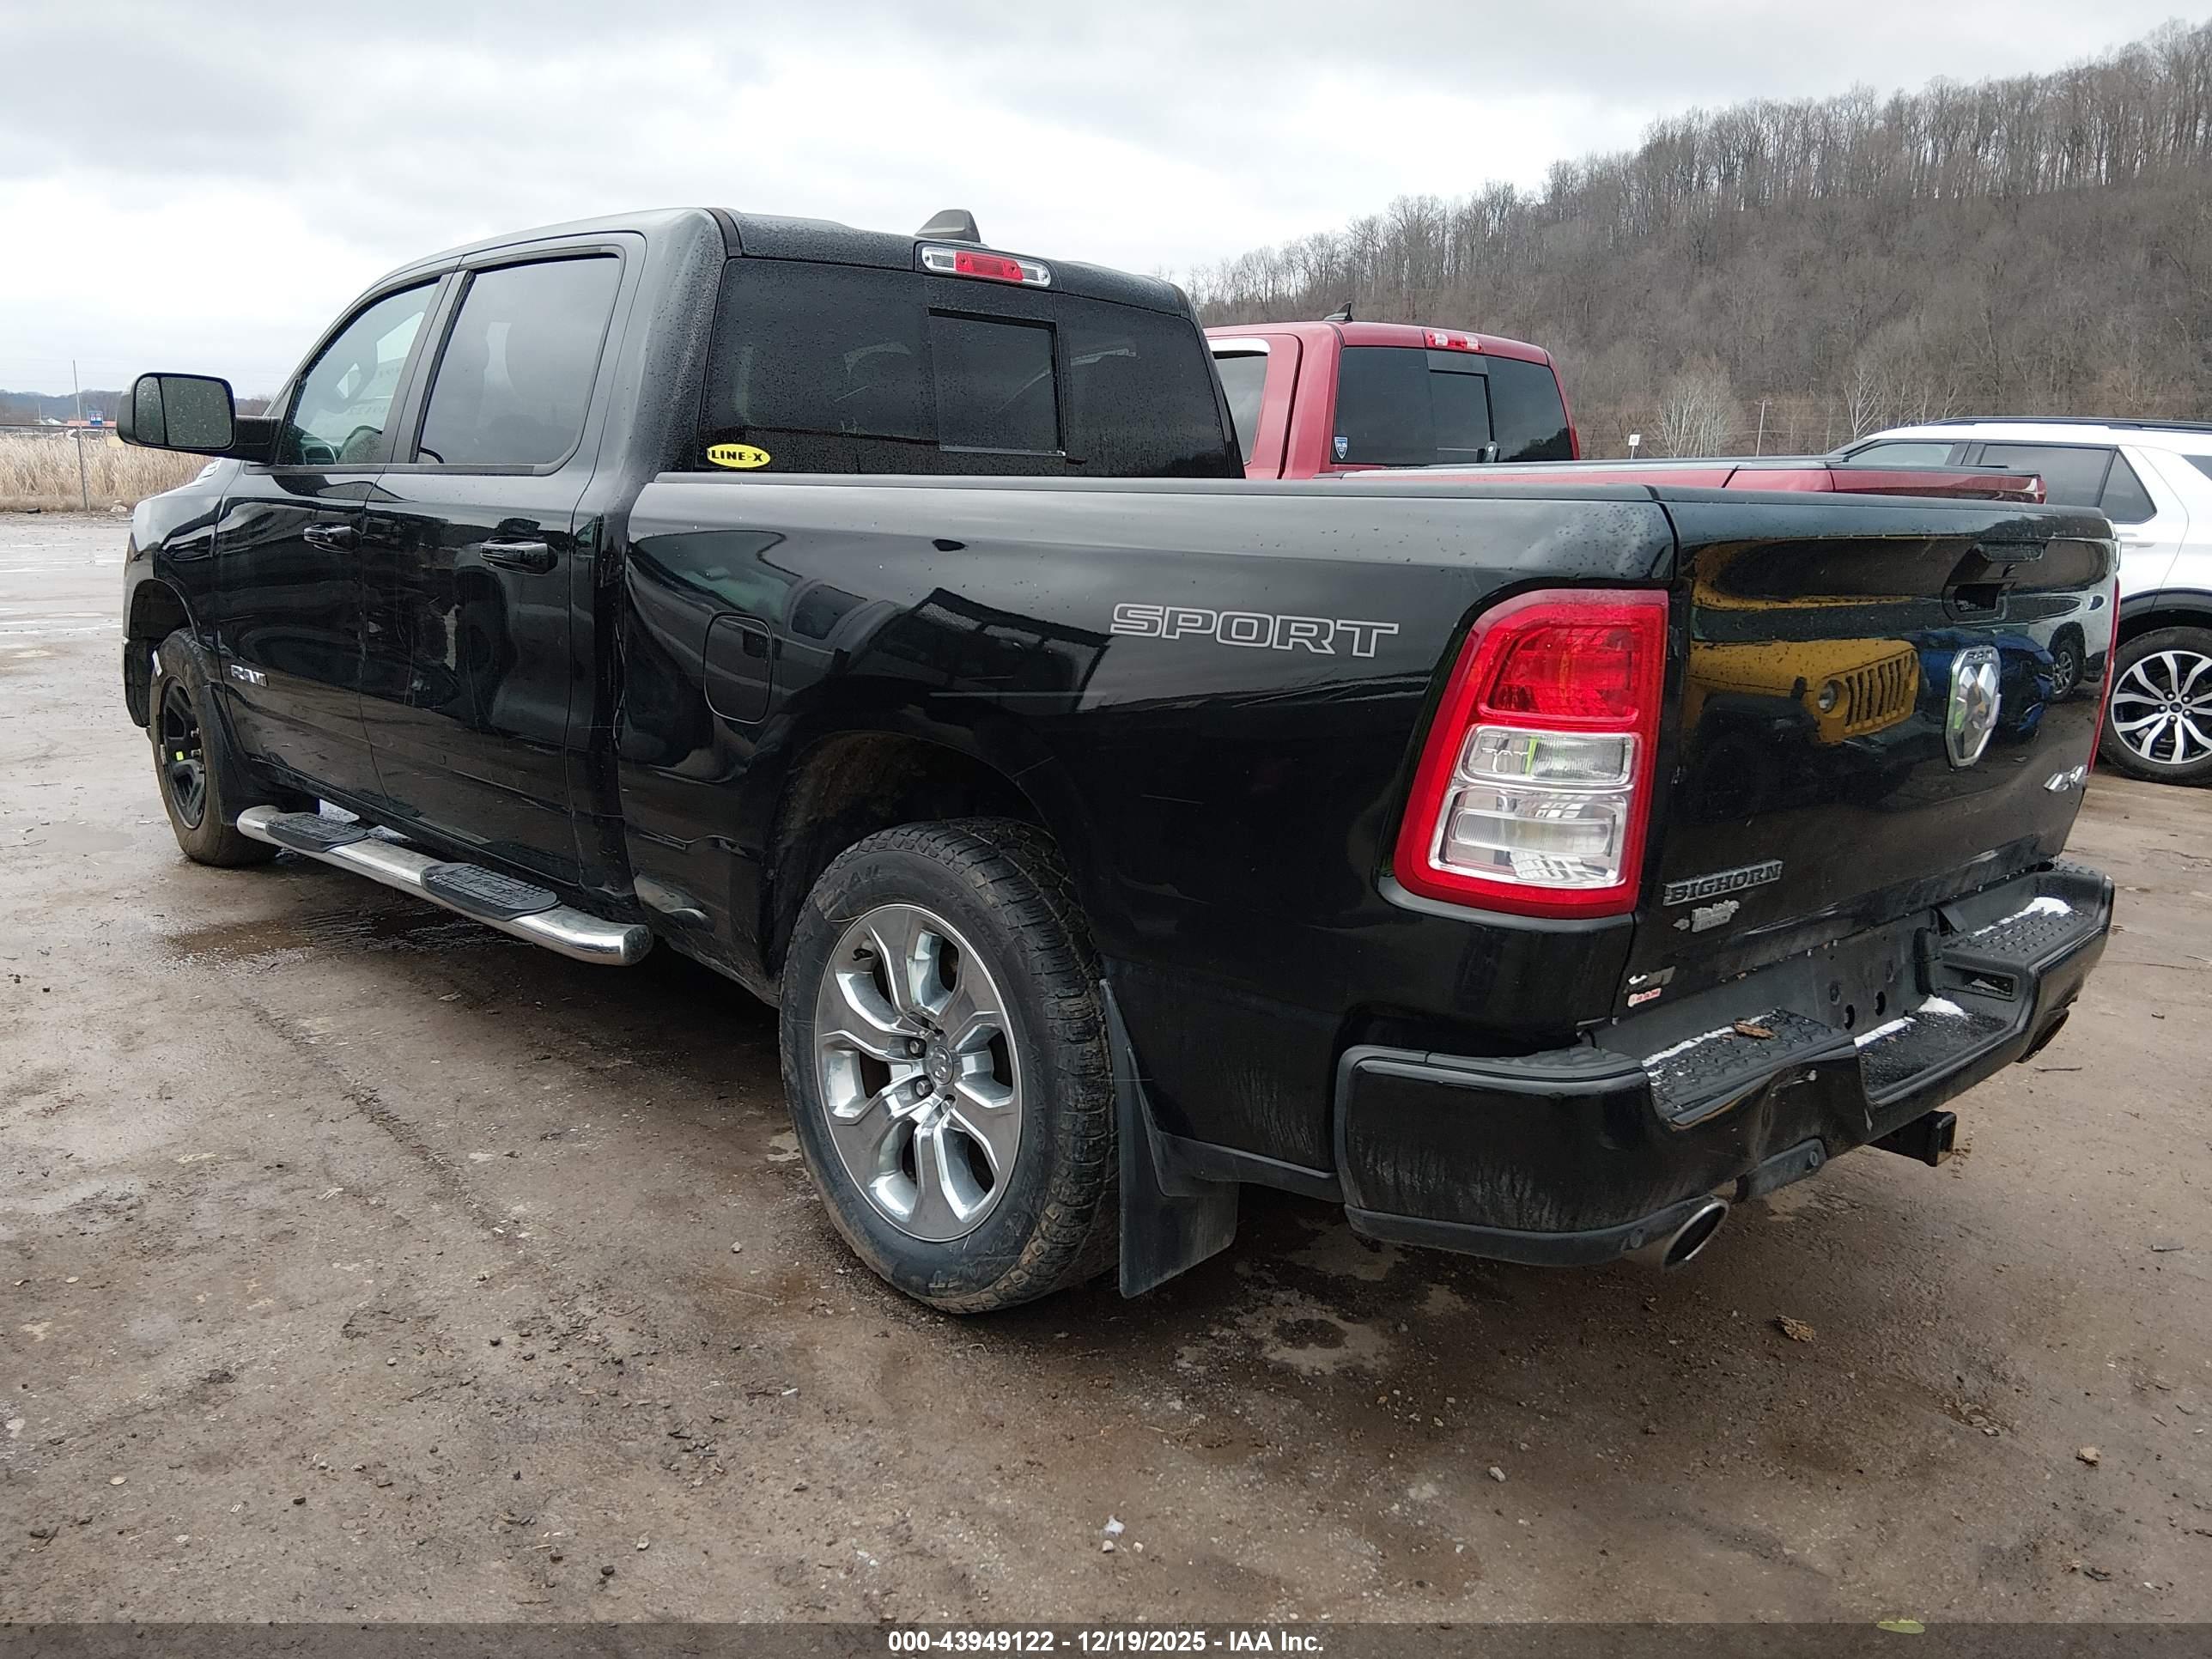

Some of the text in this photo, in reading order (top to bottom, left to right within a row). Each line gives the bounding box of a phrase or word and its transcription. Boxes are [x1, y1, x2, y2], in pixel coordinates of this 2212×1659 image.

[710, 449, 763, 462] LINE-X
[1110, 603, 1399, 658] SPORT
[1966, 648, 1993, 661] RAM
[230, 665, 267, 687] RAM
[1664, 862, 1782, 904] BIGHORN
